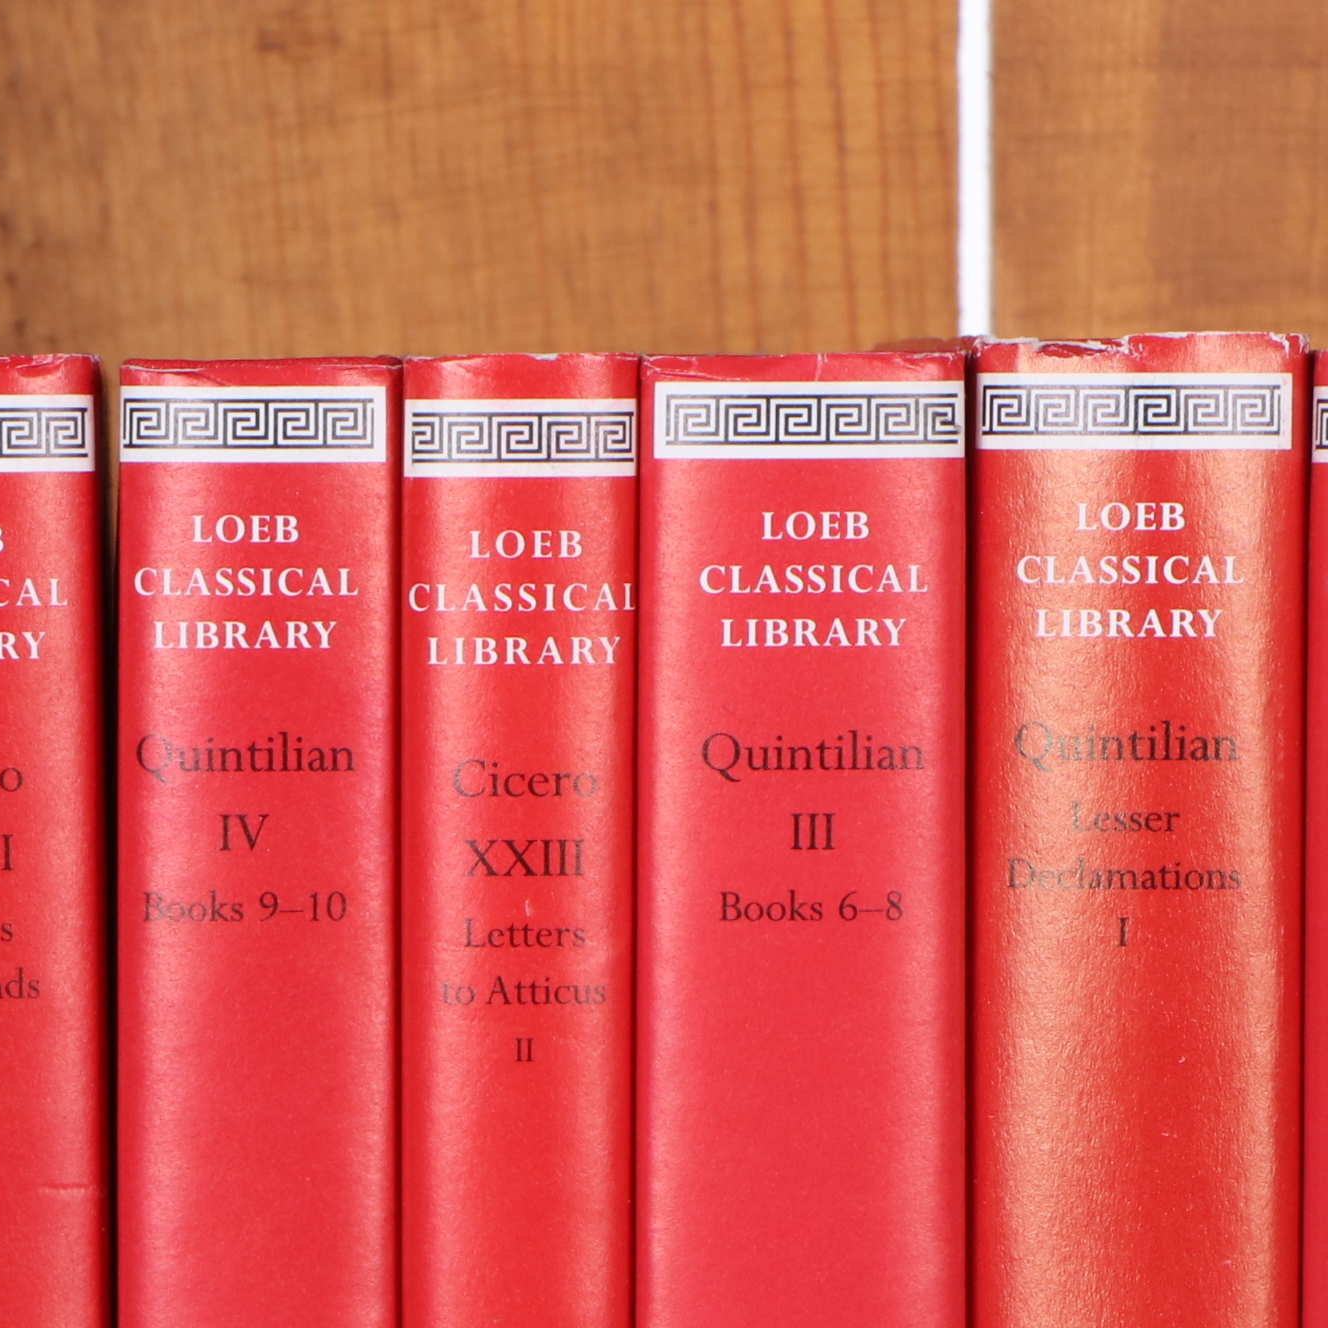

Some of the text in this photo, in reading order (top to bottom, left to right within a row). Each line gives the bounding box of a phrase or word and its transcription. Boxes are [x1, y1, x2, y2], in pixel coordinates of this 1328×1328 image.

[191, 513, 300, 544] LOEB
[760, 510, 870, 541] LOEB
[1075, 501, 1186, 532] LOEB
[469, 529, 584, 560] LOEB
[133, 566, 360, 598] CLASSICAL
[698, 563, 929, 595] CLASSICAL
[1016, 554, 1245, 586] CLASSICAL
[407, 582, 636, 613] CLASSICAL
[152, 620, 338, 650] LIBRARY
[719, 617, 907, 648] LIBRARY
[1034, 608, 1223, 639] LIBRARY
[427, 635, 622, 666] LIBRARY
[136, 730, 356, 783] Quintilian
[701, 729, 924, 782] Quintilian
[1013, 720, 1239, 771] Quintilian
[452, 758, 598, 799] Cicero
[218, 813, 270, 852] IV
[790, 811, 836, 851] III
[1069, 801, 1181, 833] Lesser
[463, 838, 585, 878] XXIII
[1006, 857, 1242, 891] Declamations
[142, 890, 245, 923] Books
[718, 889, 824, 923] Books
[462, 917, 587, 949] Letters
[1117, 916, 1129, 947] I
[441, 974, 608, 1006] to Atticus
[514, 1037, 535, 1063] II
